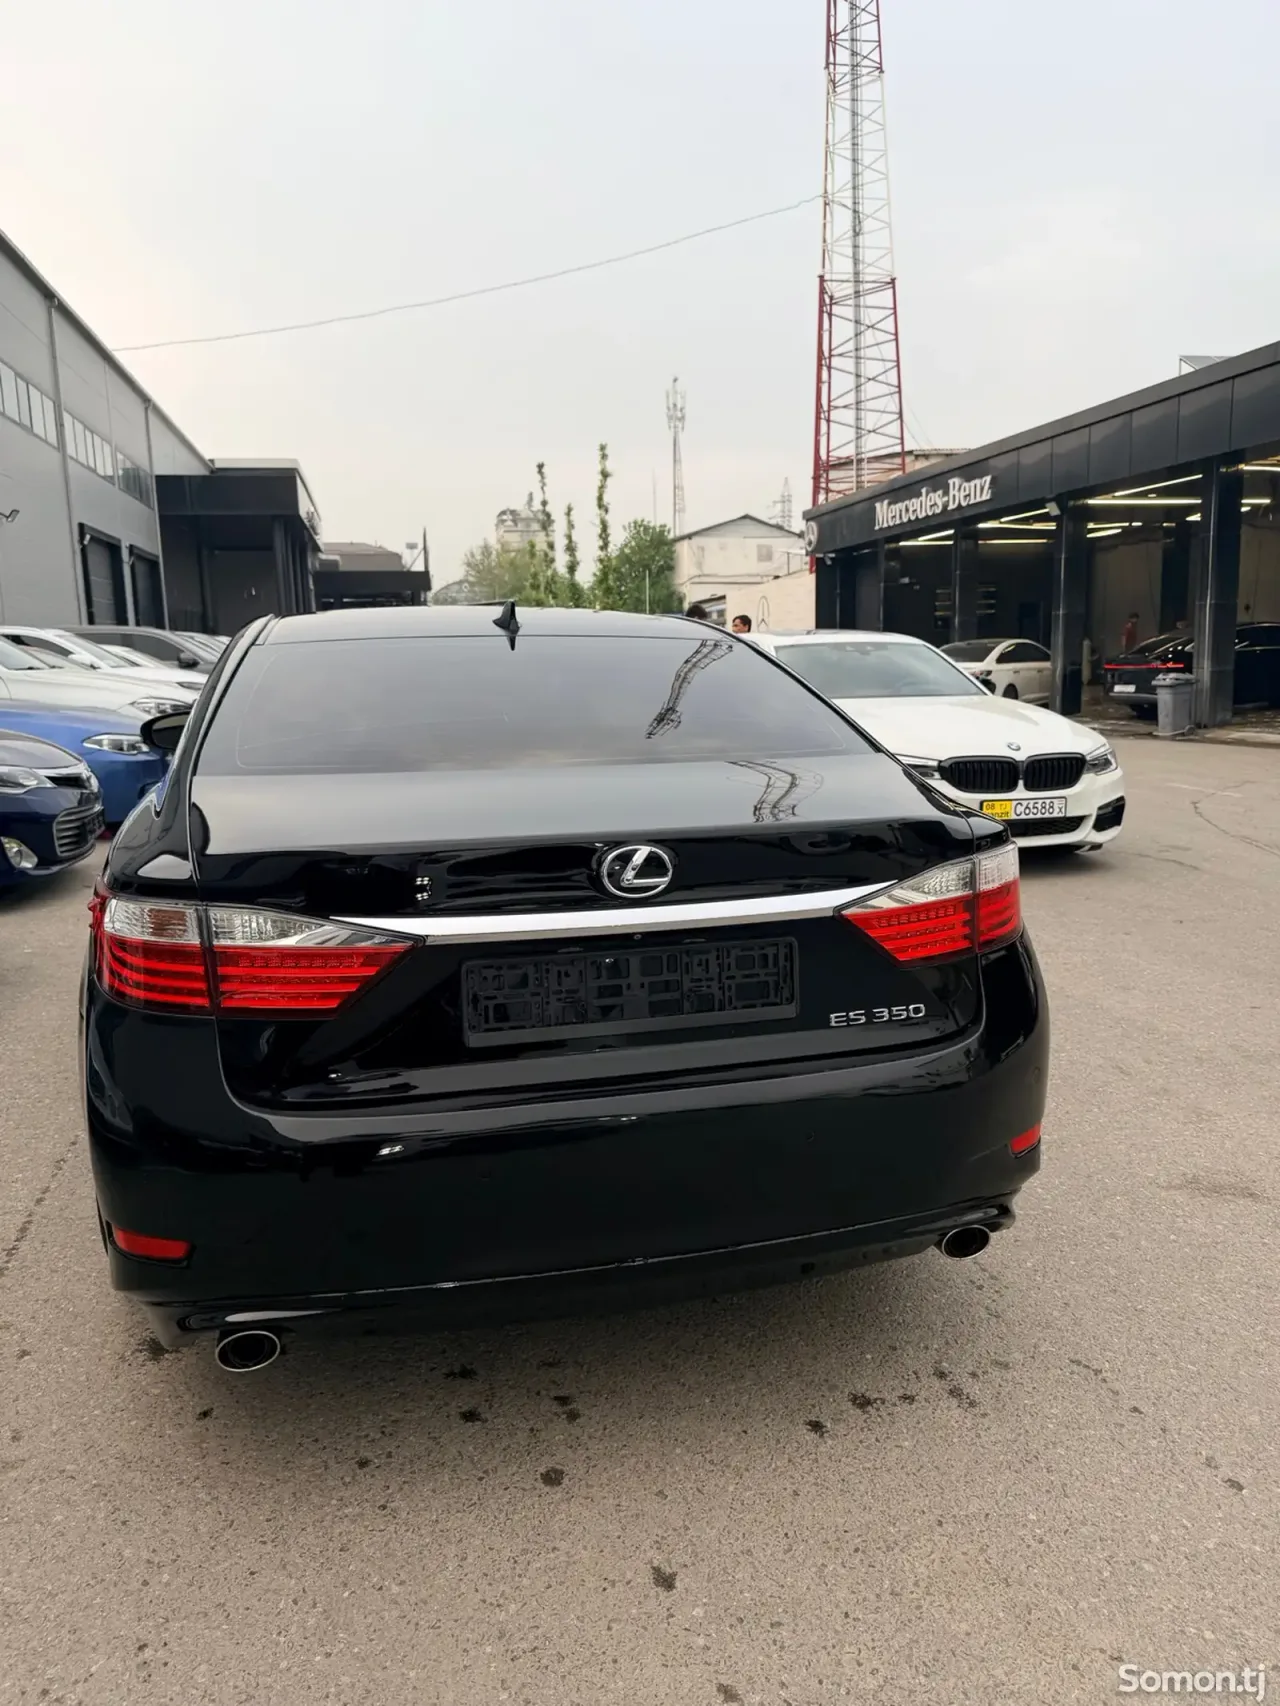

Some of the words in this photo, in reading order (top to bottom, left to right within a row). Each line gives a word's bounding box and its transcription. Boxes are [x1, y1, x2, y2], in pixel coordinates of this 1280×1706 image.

[874, 475, 992, 530] Mercedes-Benz
[985, 803, 996, 811] 08
[999, 803, 1008, 811] TJ
[1014, 801, 1055, 817] C6588
[829, 1010, 866, 1027] ES
[872, 1003, 926, 1022] 350
